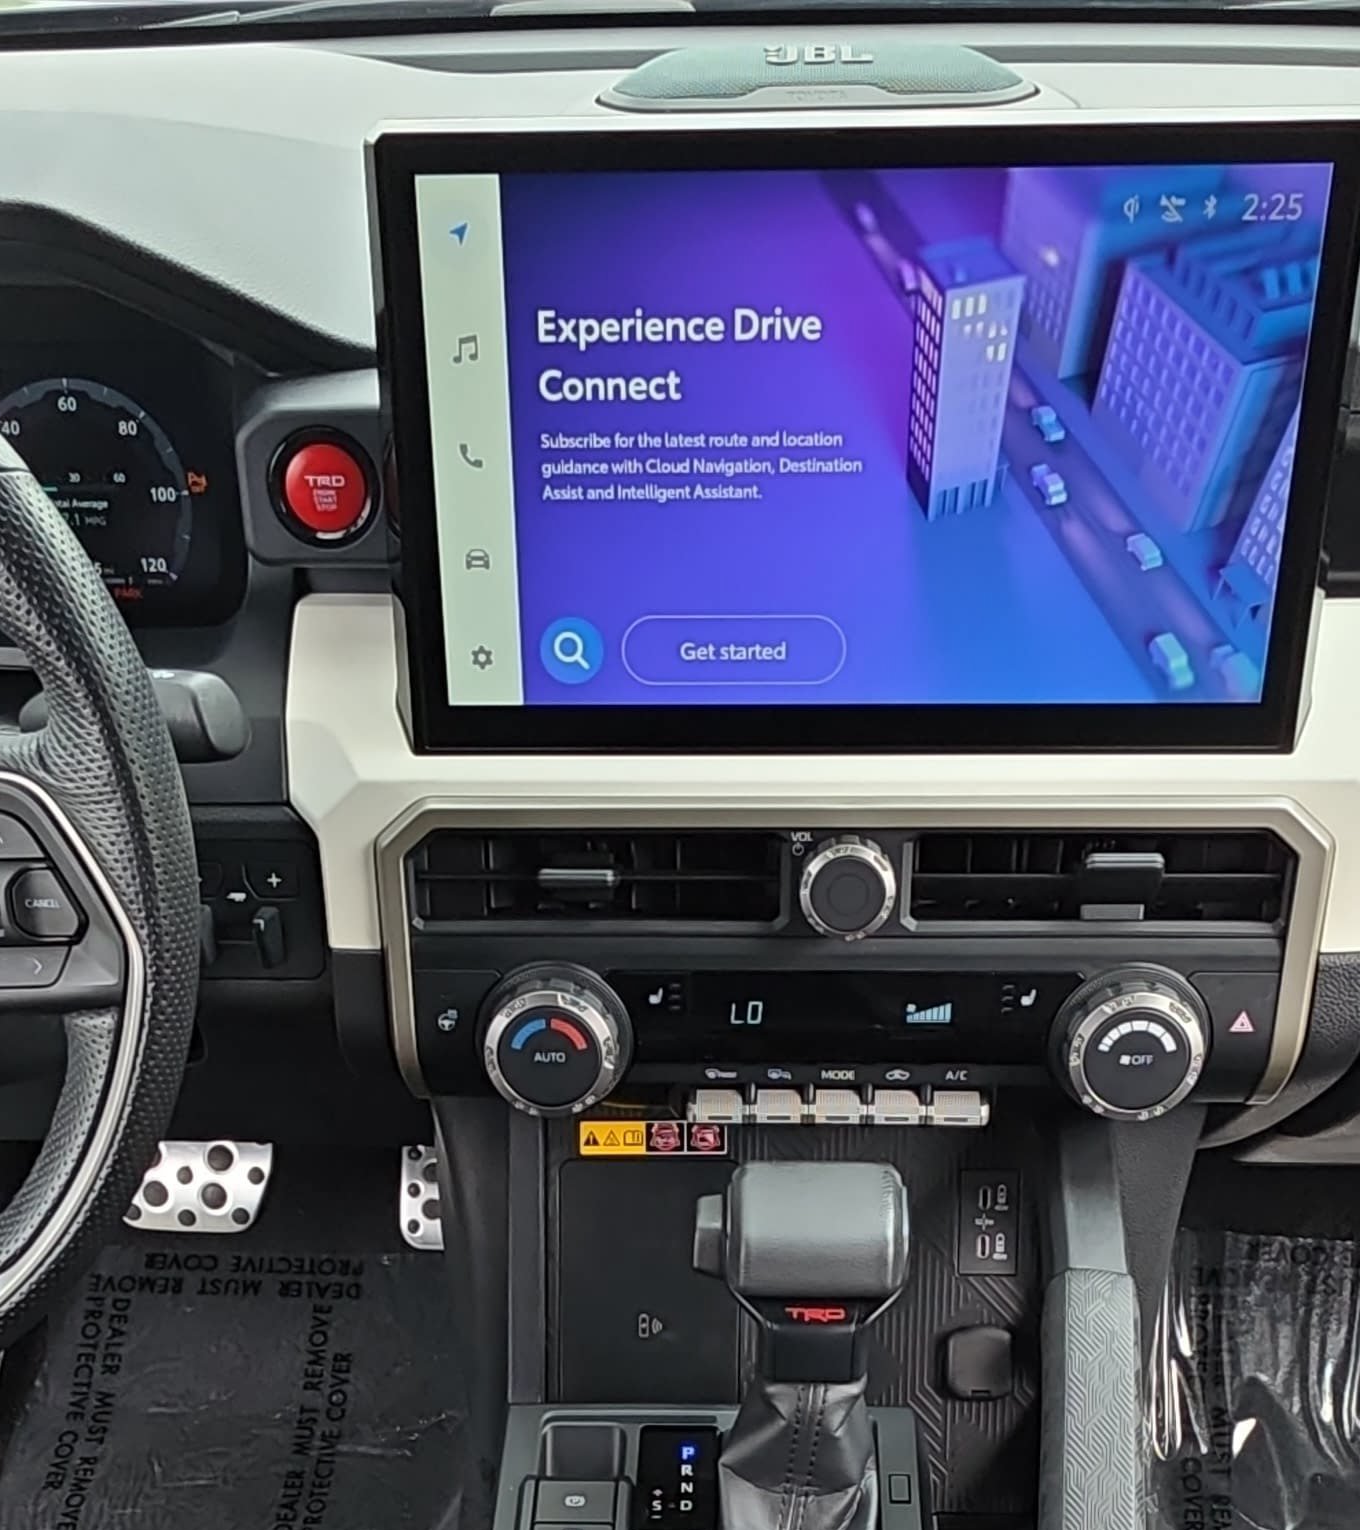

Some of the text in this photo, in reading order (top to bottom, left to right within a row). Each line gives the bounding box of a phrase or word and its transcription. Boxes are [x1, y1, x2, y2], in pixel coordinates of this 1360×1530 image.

[763, 44, 874, 66] JBL
[1241, 193, 1304, 221] 2:25
[537, 307, 823, 351] Experience Drive
[539, 369, 682, 401] Connect
[57, 397, 77, 411] 60
[1, 421, 20, 436] 40
[118, 421, 137, 436] 80
[540, 431, 843, 449] Subscribe for the latest route and location
[541, 458, 862, 478] guidance with Cloud Navigation, Destination
[304, 475, 345, 487] TRD
[150, 487, 176, 502] 100
[543, 484, 762, 503] Assist and Intelligent Assistant.
[141, 557, 167, 572] 120
[680, 641, 787, 661] Get started
[790, 831, 814, 842] VOL
[25, 898, 61, 909] CANCEL
[533, 1052, 566, 1063] AUTO
[1131, 1054, 1154, 1066] OFF
[821, 1069, 856, 1081] MODE
[945, 1069, 968, 1081] A/C
[144, 1253, 364, 1276] PROTECTIVE COVER
[89, 1273, 362, 1300] DEALER MUST REMOVE
[784, 1307, 846, 1322] TRD
[101, 1298, 131, 1376] DEALER
[304, 1304, 333, 1393] REMOVE
[42, 1297, 105, 1491] PROTECTIVE COVER
[327, 1352, 353, 1423] COVER
[85, 1390, 114, 1446] MUST
[294, 1405, 321, 1456] MUST
[681, 1446, 695, 1460] P
[680, 1464, 693, 1477] R
[680, 1481, 693, 1494] N
[652, 1500, 692, 1511] S D
